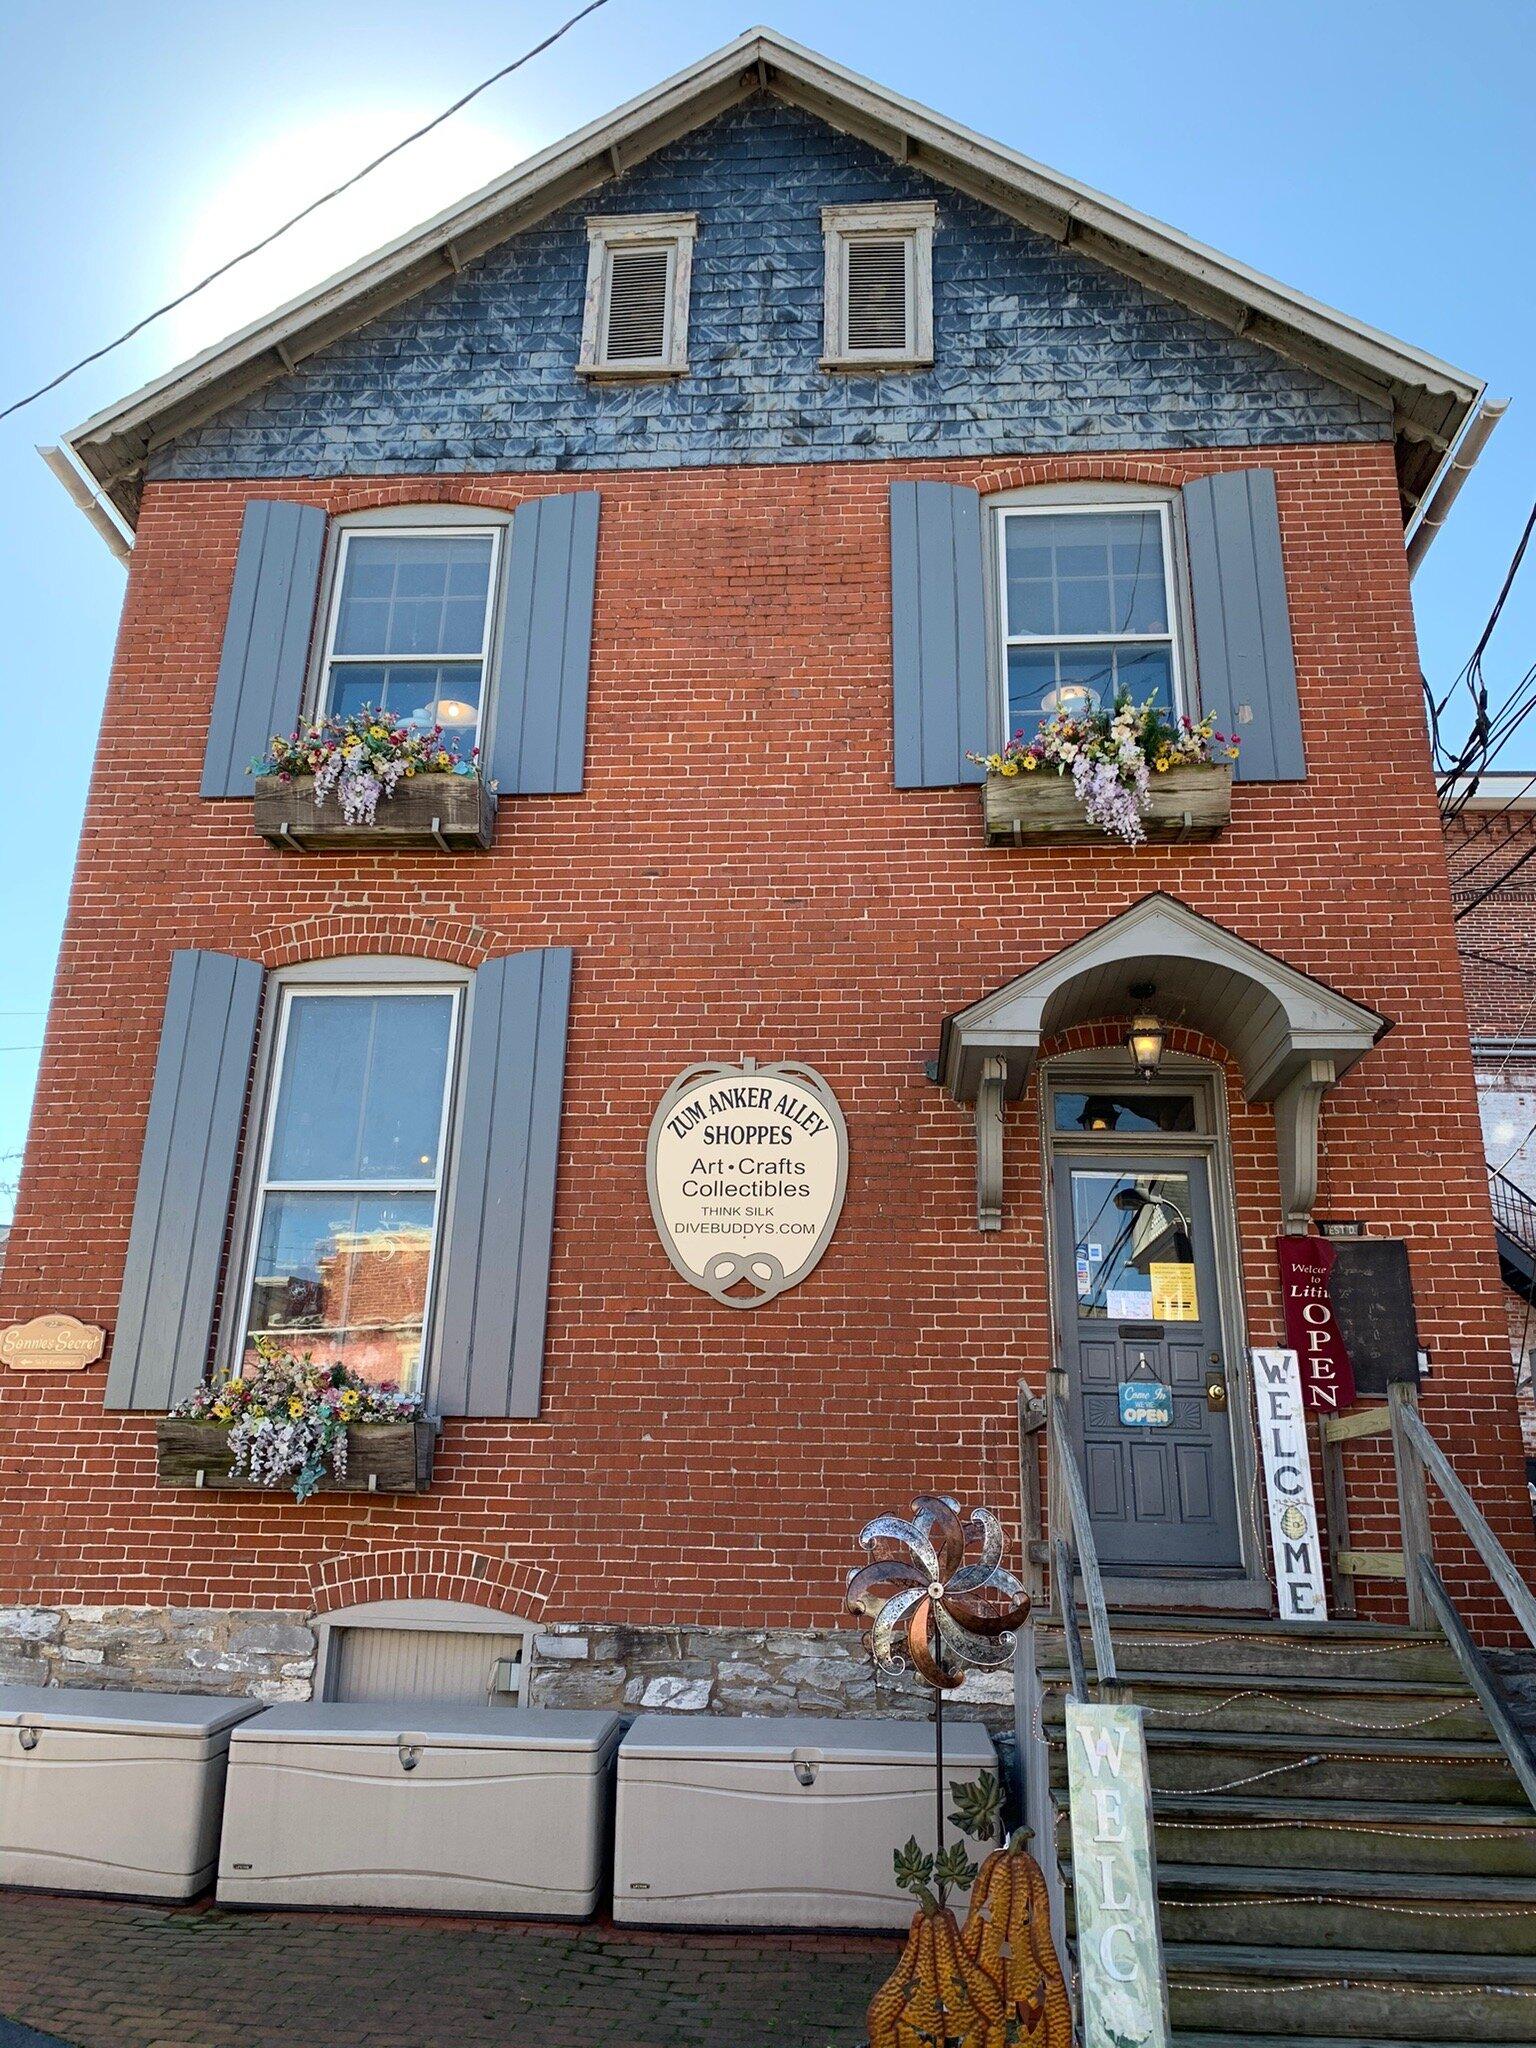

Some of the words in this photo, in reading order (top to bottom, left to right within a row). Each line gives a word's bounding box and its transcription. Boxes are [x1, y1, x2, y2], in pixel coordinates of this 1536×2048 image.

[667, 1101, 708, 1139] ZUM
[708, 1087, 772, 1115] ANKER
[774, 1094, 829, 1137] ALLEY
[703, 1125, 793, 1145] SHOPPES
[690, 1158, 724, 1175] Art
[738, 1157, 806, 1175] Crafts
[682, 1180, 810, 1197] Collectibles
[701, 1206, 741, 1216] THINK
[745, 1206, 775, 1217] SILK
[674, 1222, 816, 1235] DIVEBUDDYS.COM
[1311, 1275, 1321, 1284] to
[55, 1330, 100, 1351] Secret
[1302, 1303, 1340, 1407] OPEN
[1124, 1386, 1150, 1401] Come
[1153, 1387, 1167, 1400] In
[1123, 1408, 1168, 1423] OPEN
